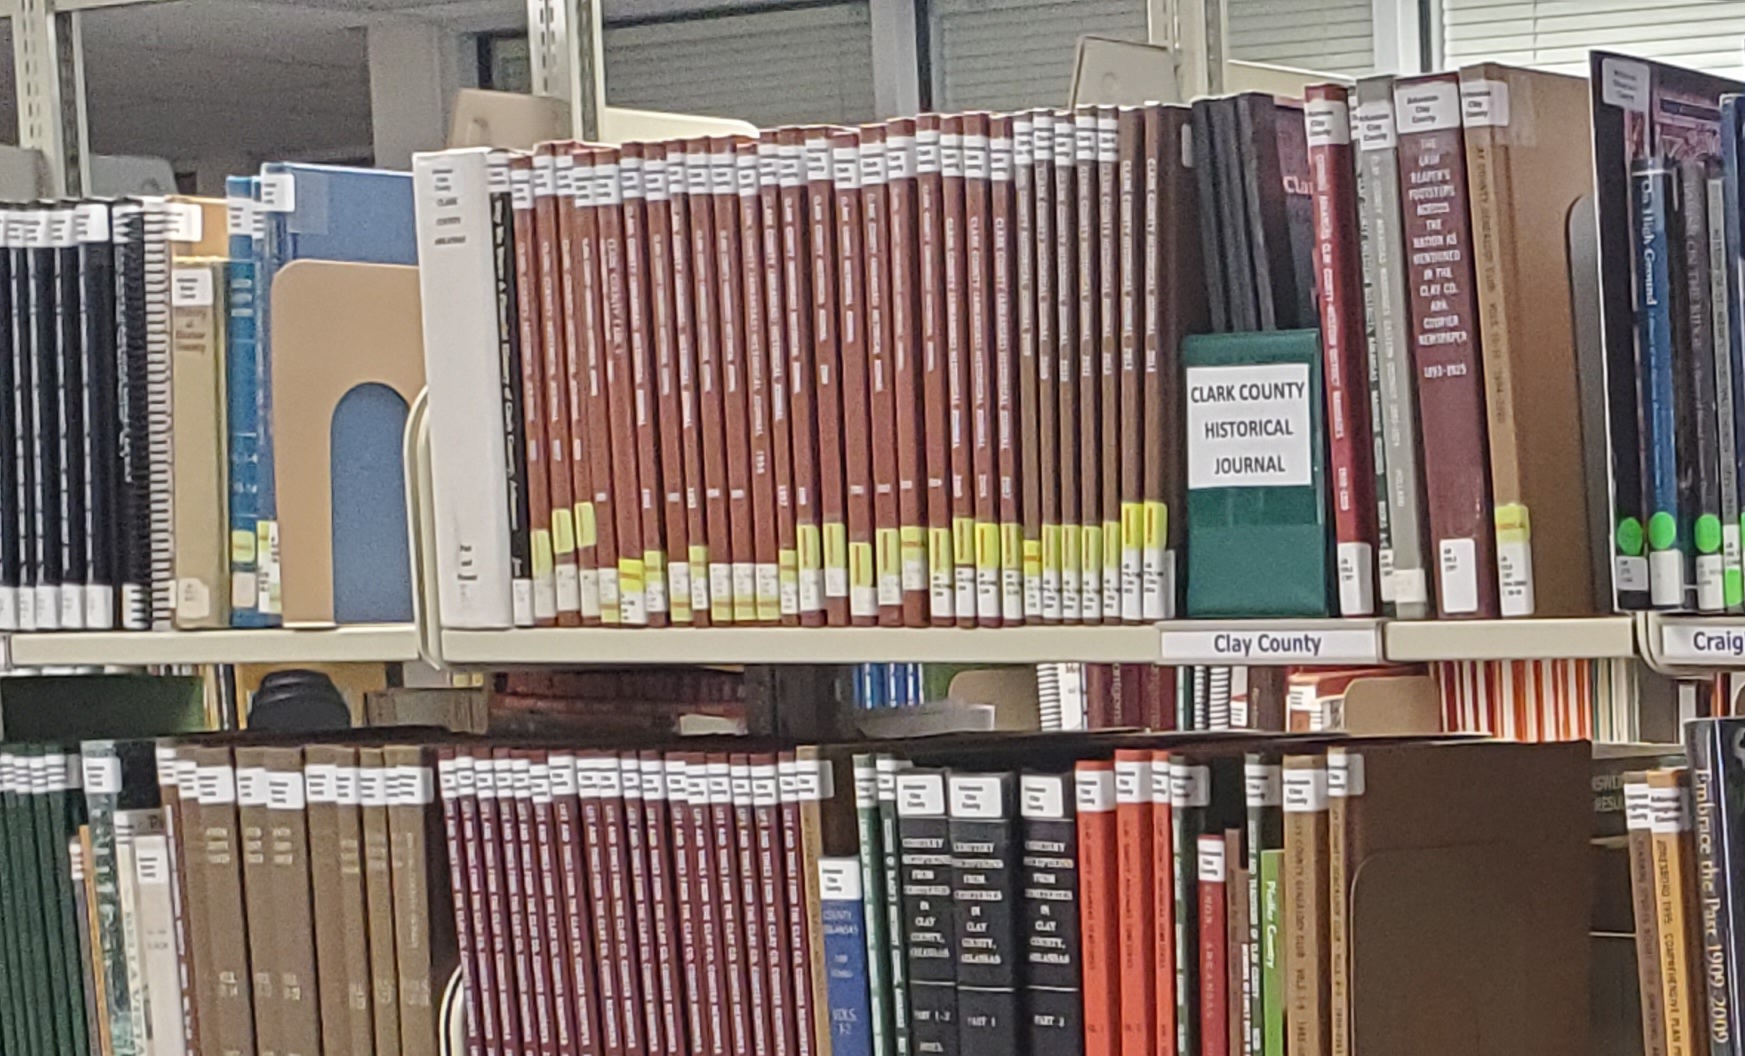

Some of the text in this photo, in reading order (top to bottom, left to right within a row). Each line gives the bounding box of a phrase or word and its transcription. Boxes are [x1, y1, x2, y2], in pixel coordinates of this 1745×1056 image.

[1191, 382, 1305, 403] CLARK COUNTY
[1204, 418, 1294, 439] HISTORICAL
[1214, 455, 1286, 475] JOURNAL
[1213, 633, 1322, 656] Clay County
[1700, 859, 1720, 892] the
[1703, 896, 1722, 937] Past
